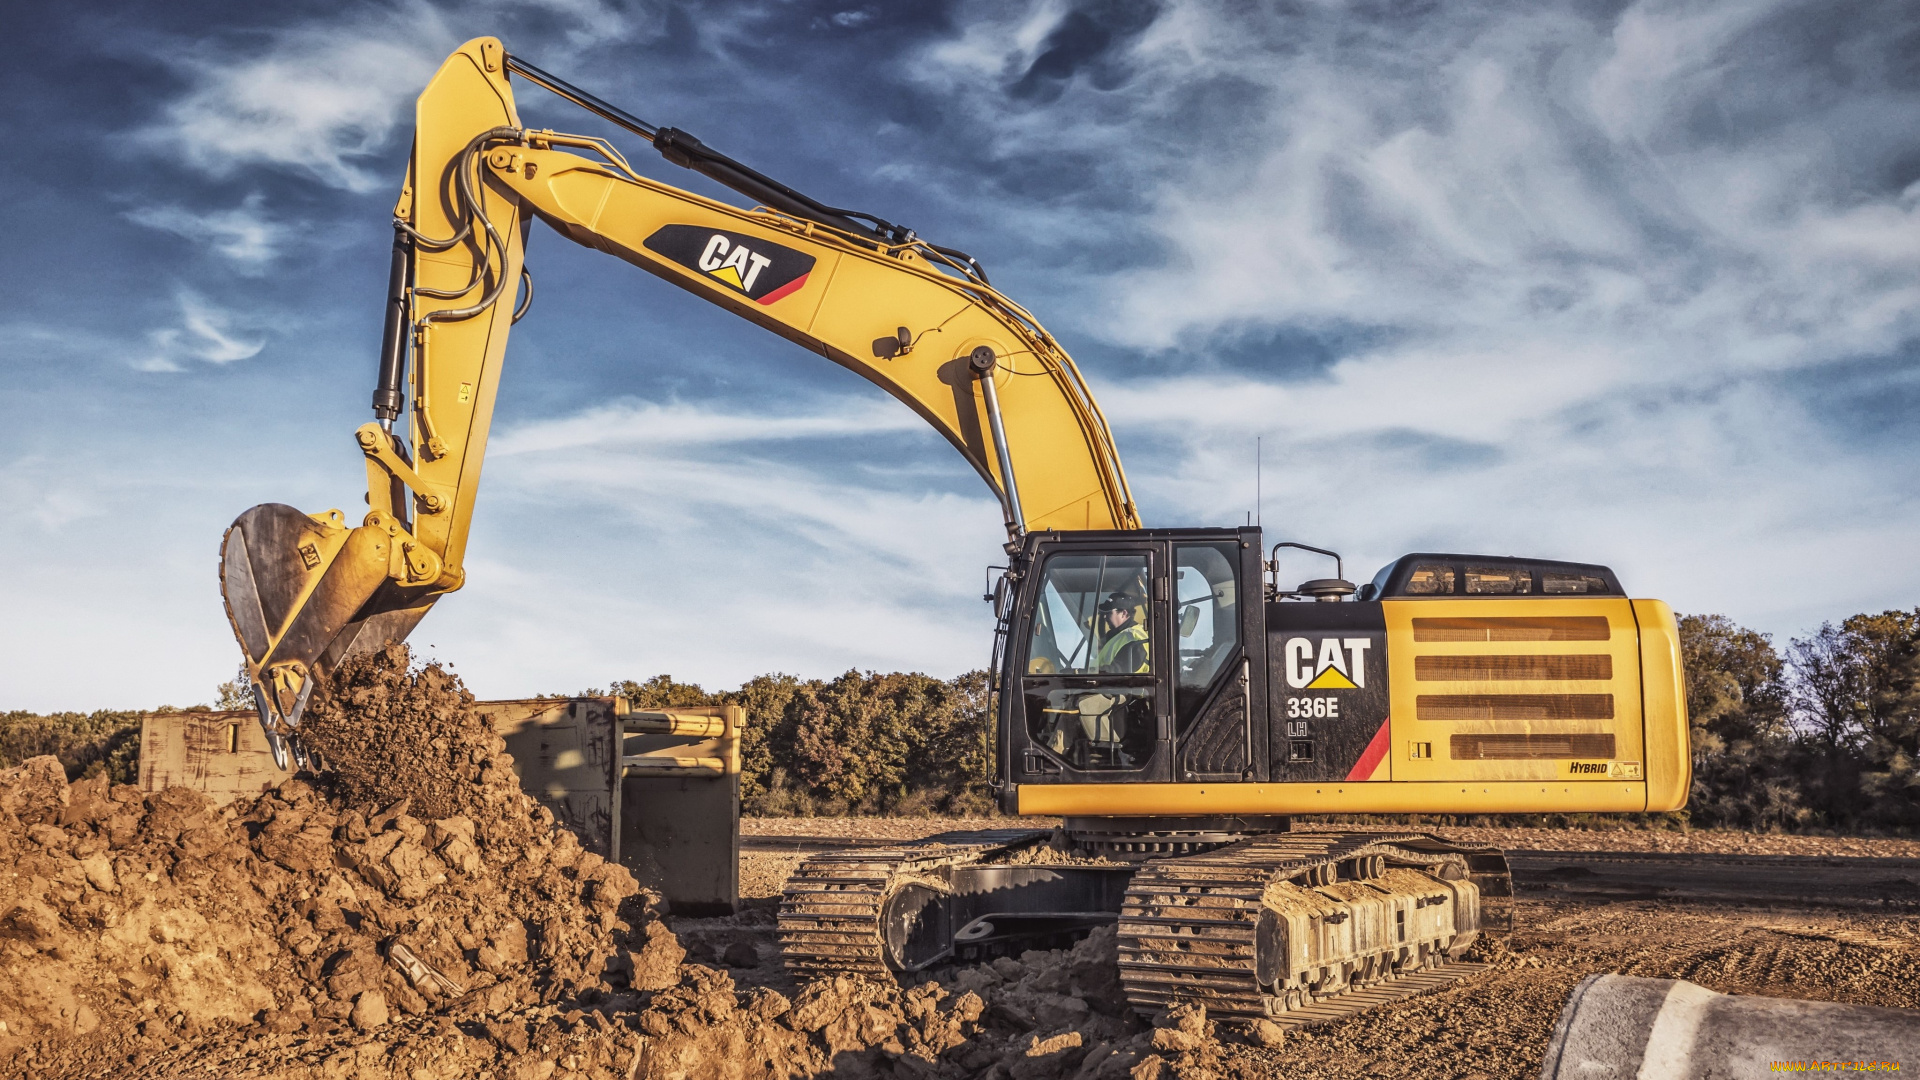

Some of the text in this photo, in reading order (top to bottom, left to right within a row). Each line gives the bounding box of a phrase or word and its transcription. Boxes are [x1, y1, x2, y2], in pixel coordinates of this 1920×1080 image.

[699, 234, 771, 292] CAT
[1285, 637, 1371, 689] CAT
[1287, 697, 1339, 718] 336E
[1287, 721, 1307, 737] LH
[1570, 762, 1608, 774] HYBRID
